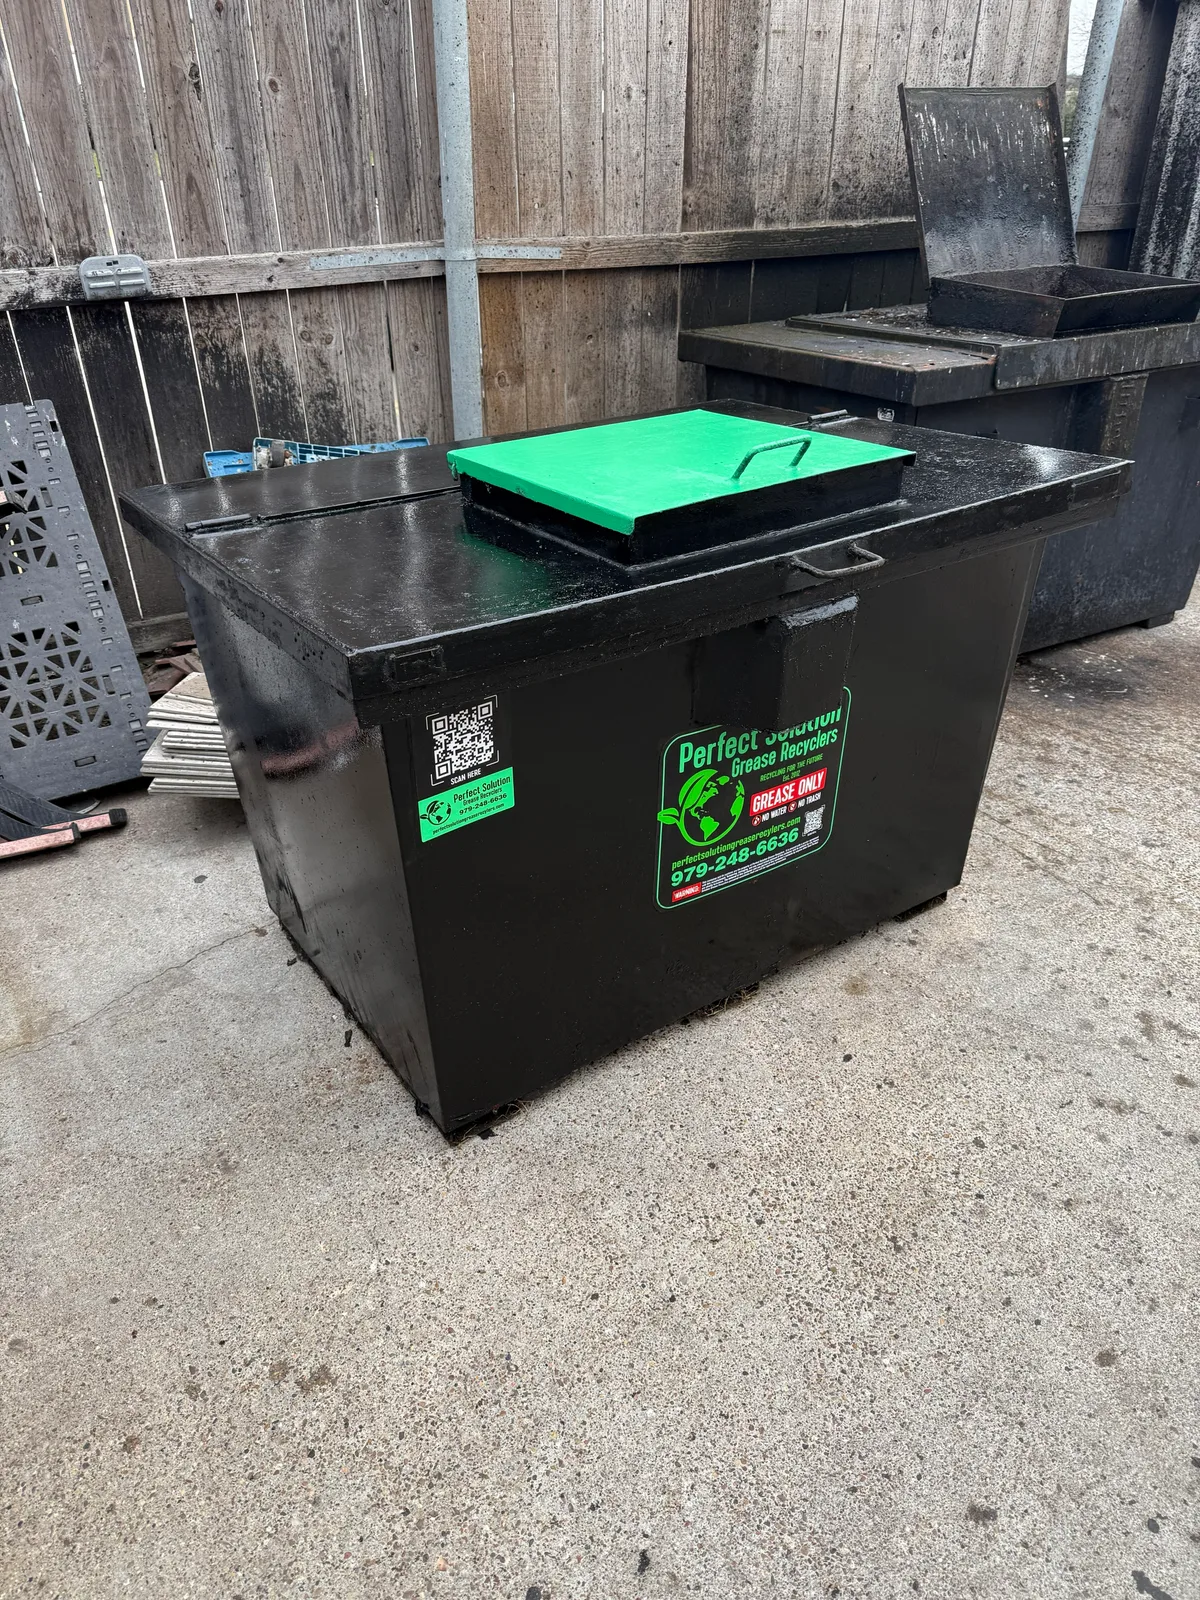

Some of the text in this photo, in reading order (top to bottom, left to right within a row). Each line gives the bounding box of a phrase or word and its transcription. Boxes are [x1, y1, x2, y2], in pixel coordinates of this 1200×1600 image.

[679, 730, 758, 773] Perfect
[731, 728, 838, 778] Grease Recyclers
[760, 753, 824, 782] RECYCLING FOR THE FUTURE
[450, 767, 481, 786] SCAN HERE
[453, 776, 511, 803] Perfect Solution
[752, 771, 824, 813] GREASE ONLY
[459, 793, 508, 815] 979-248-6636
[463, 787, 503, 806] Grease Recyclers
[761, 791, 822, 823] NO WATER NO TRASH
[671, 816, 801, 871] perfectsolutiongreaserecylers.com
[671, 827, 799, 887] 979-248-6636
